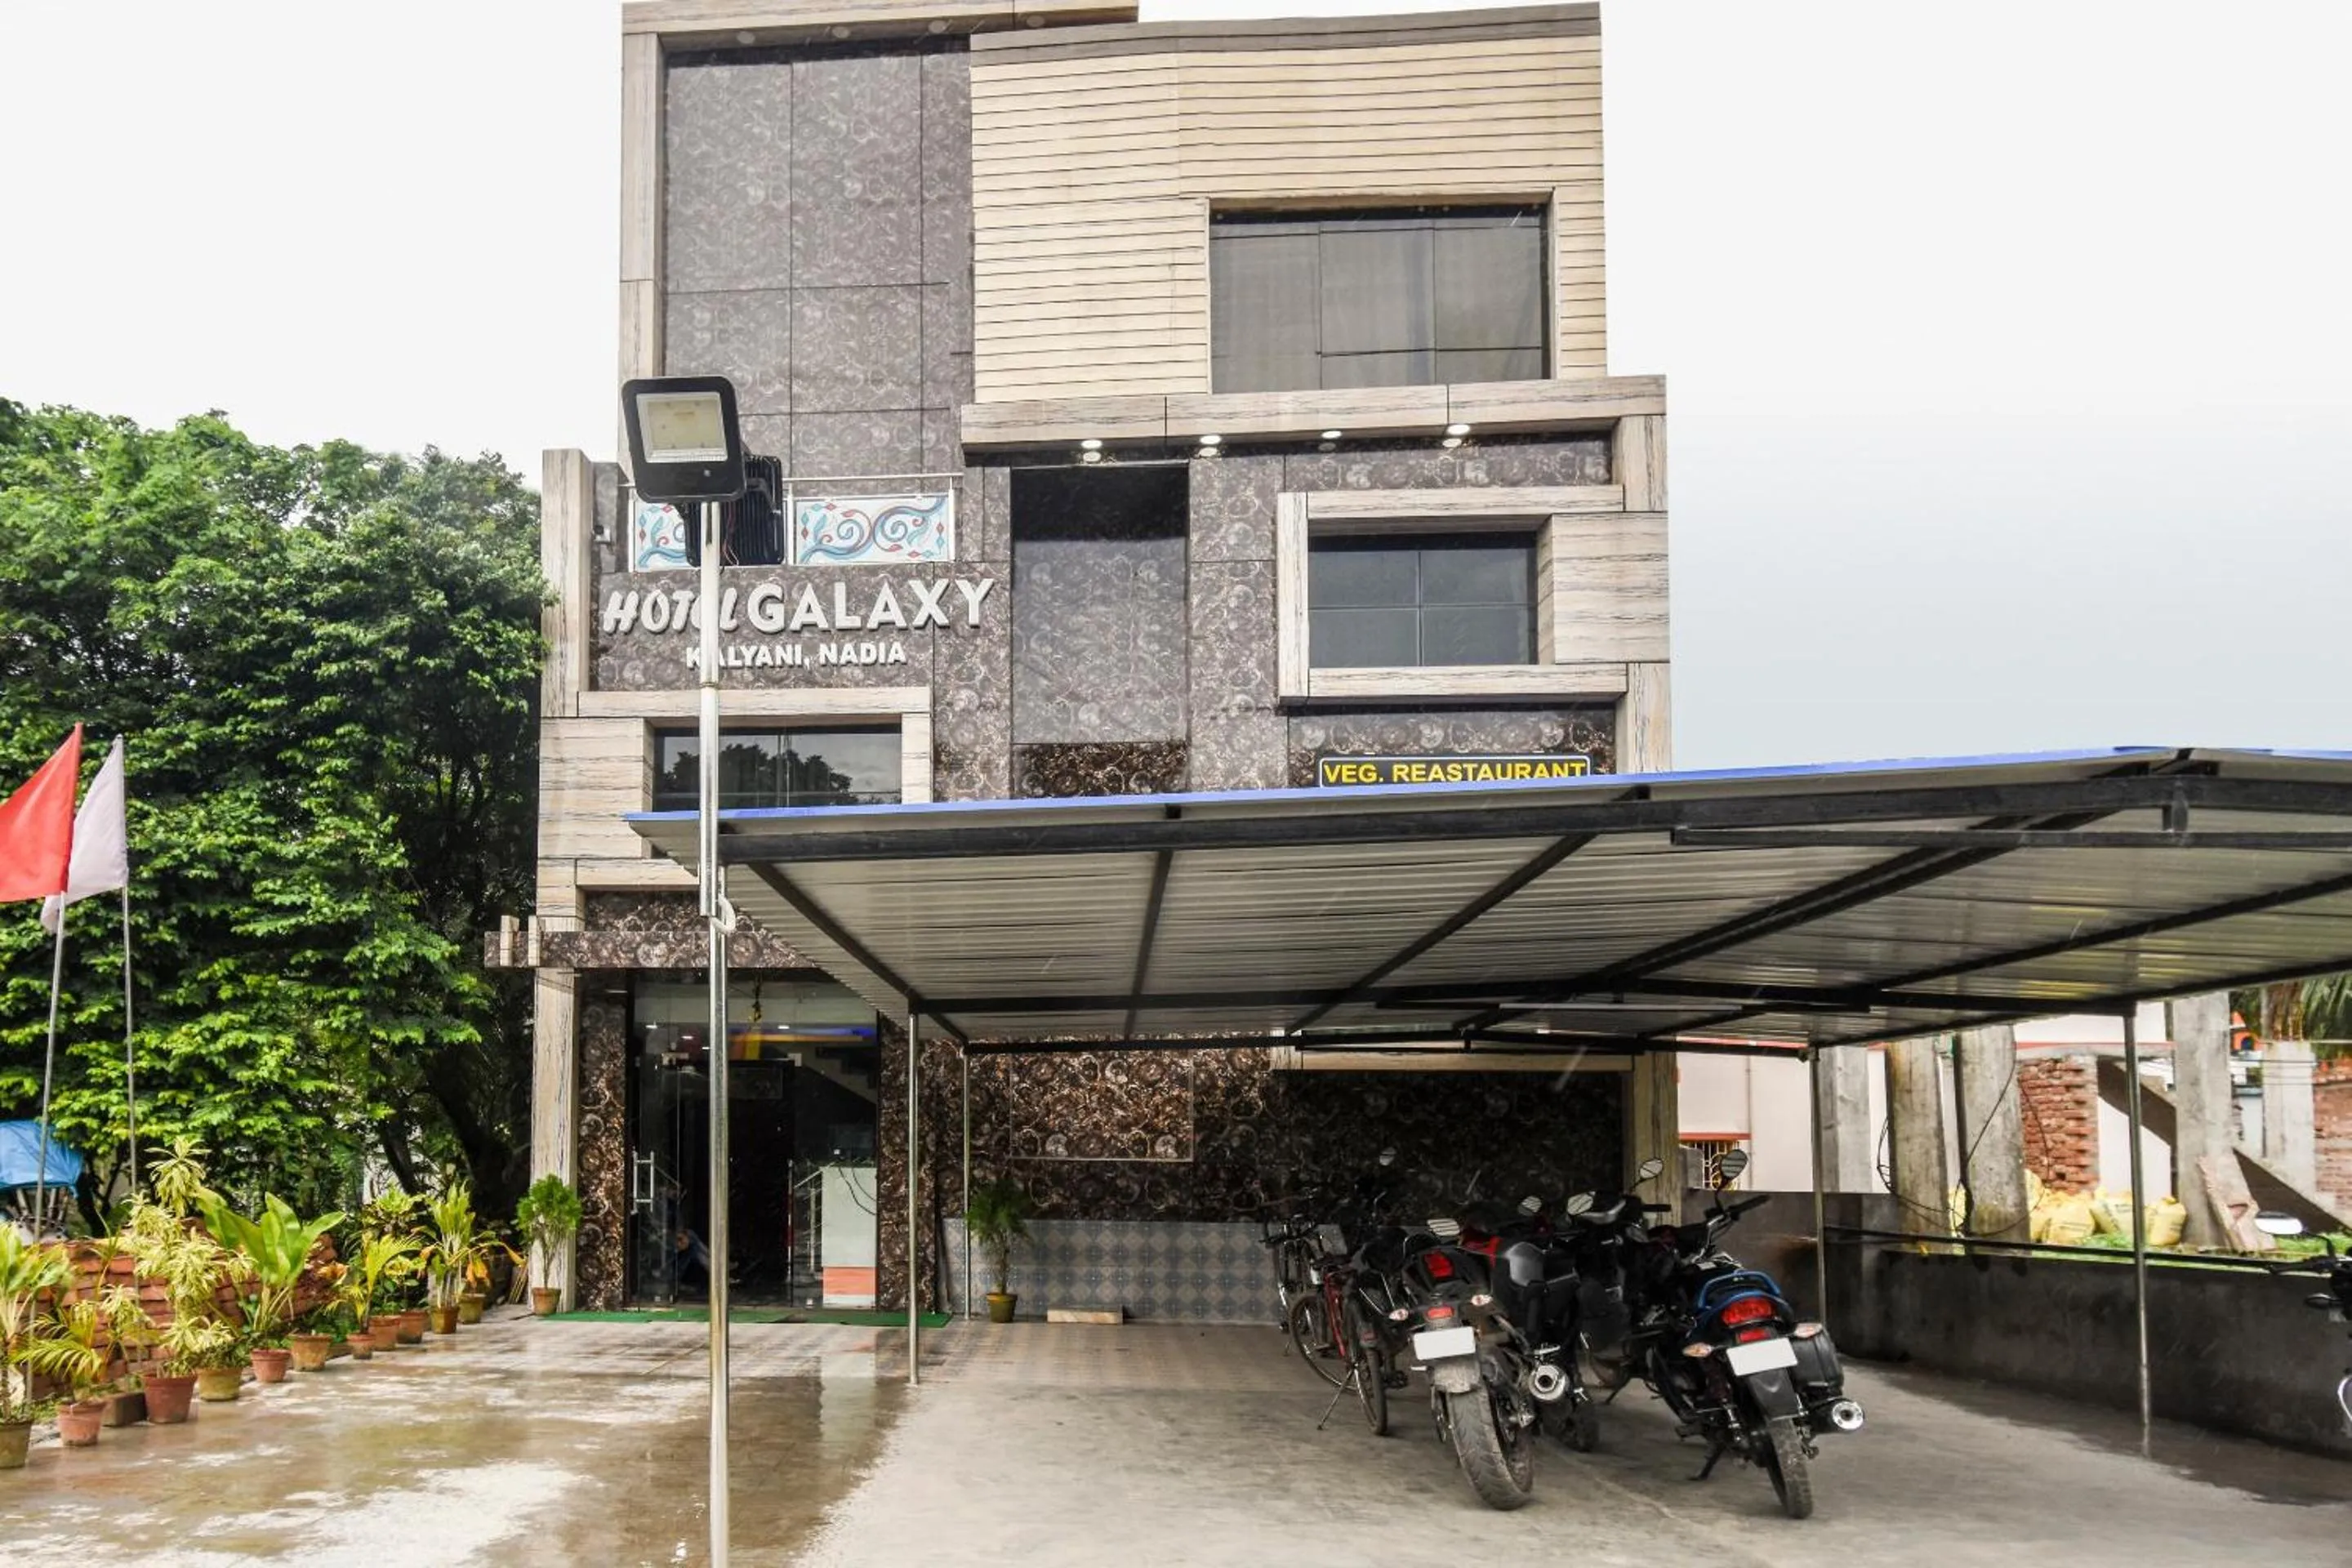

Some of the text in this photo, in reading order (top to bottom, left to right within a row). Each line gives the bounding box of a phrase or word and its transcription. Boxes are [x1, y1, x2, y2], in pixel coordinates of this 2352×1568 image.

[747, 578, 995, 634] GALAXY
[818, 641, 908, 666] NADIA
[1323, 762, 1587, 783] VEG. REASTAURANT
